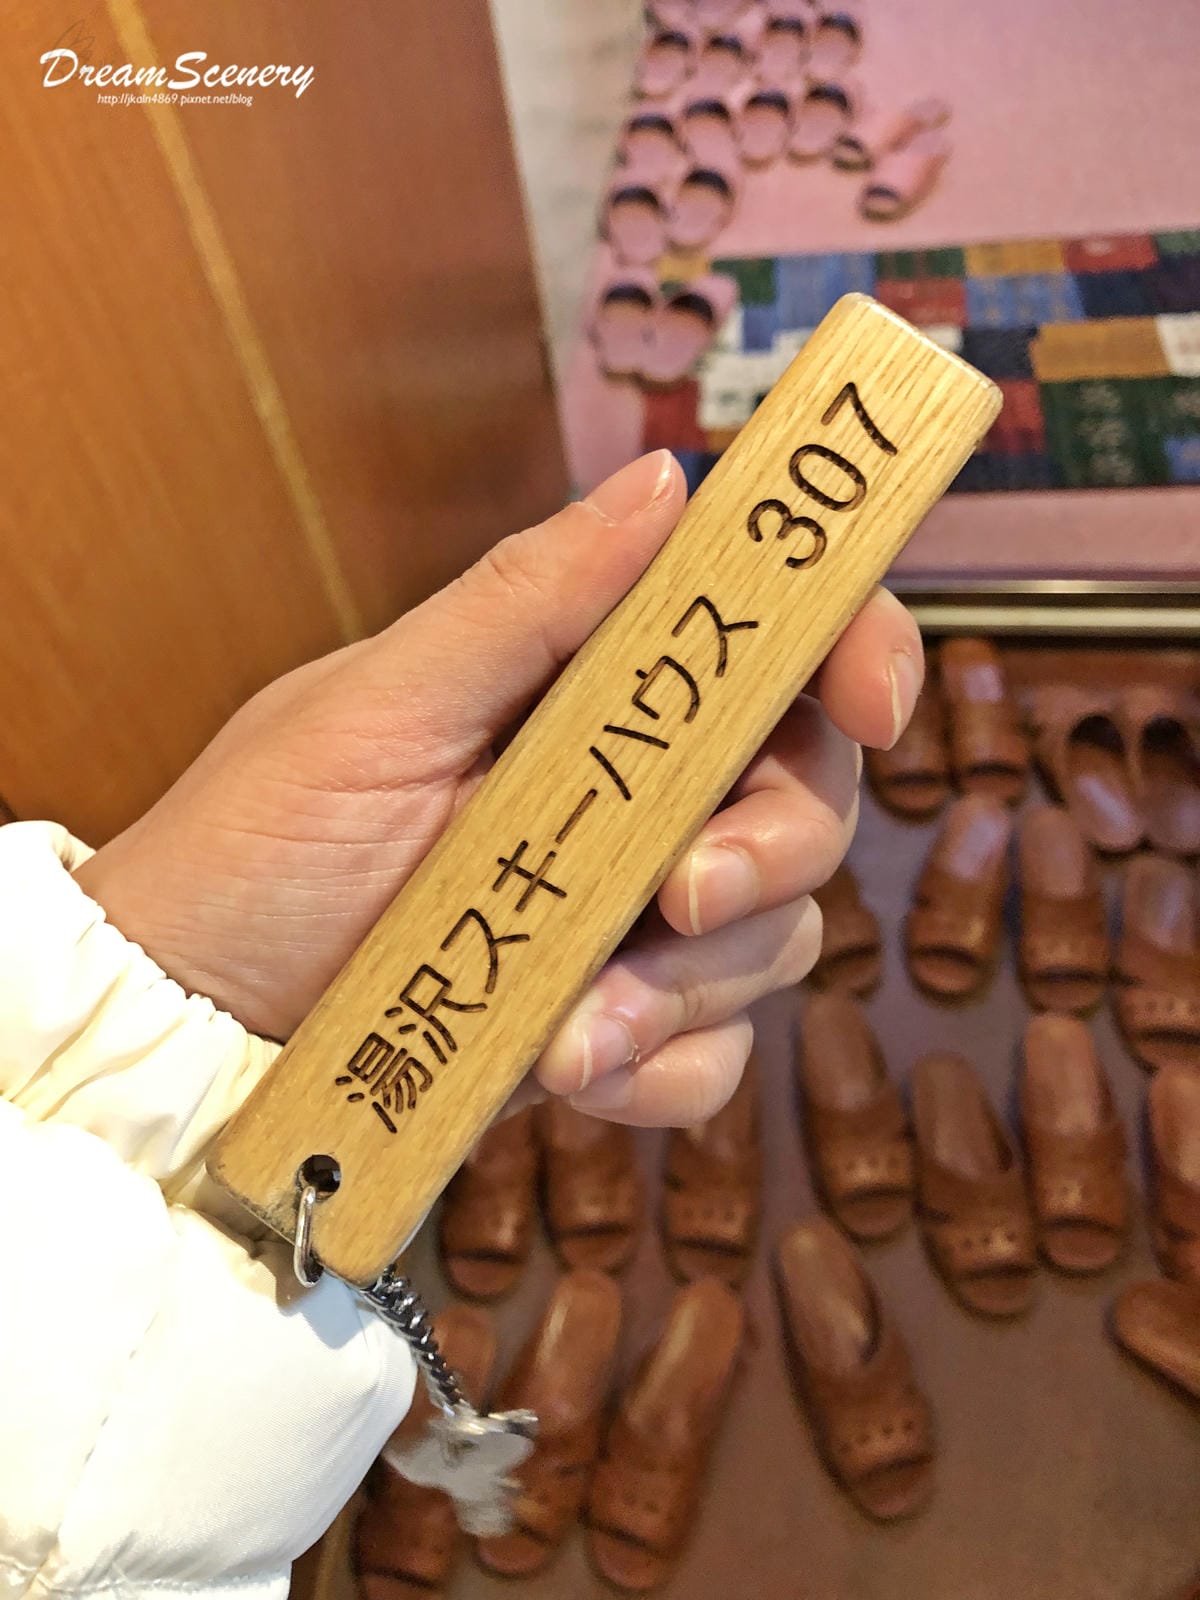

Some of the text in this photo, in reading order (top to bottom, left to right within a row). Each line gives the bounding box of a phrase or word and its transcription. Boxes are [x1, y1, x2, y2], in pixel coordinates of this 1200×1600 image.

[335, 382, 898, 1133] 湯沢スキーハウス 307
